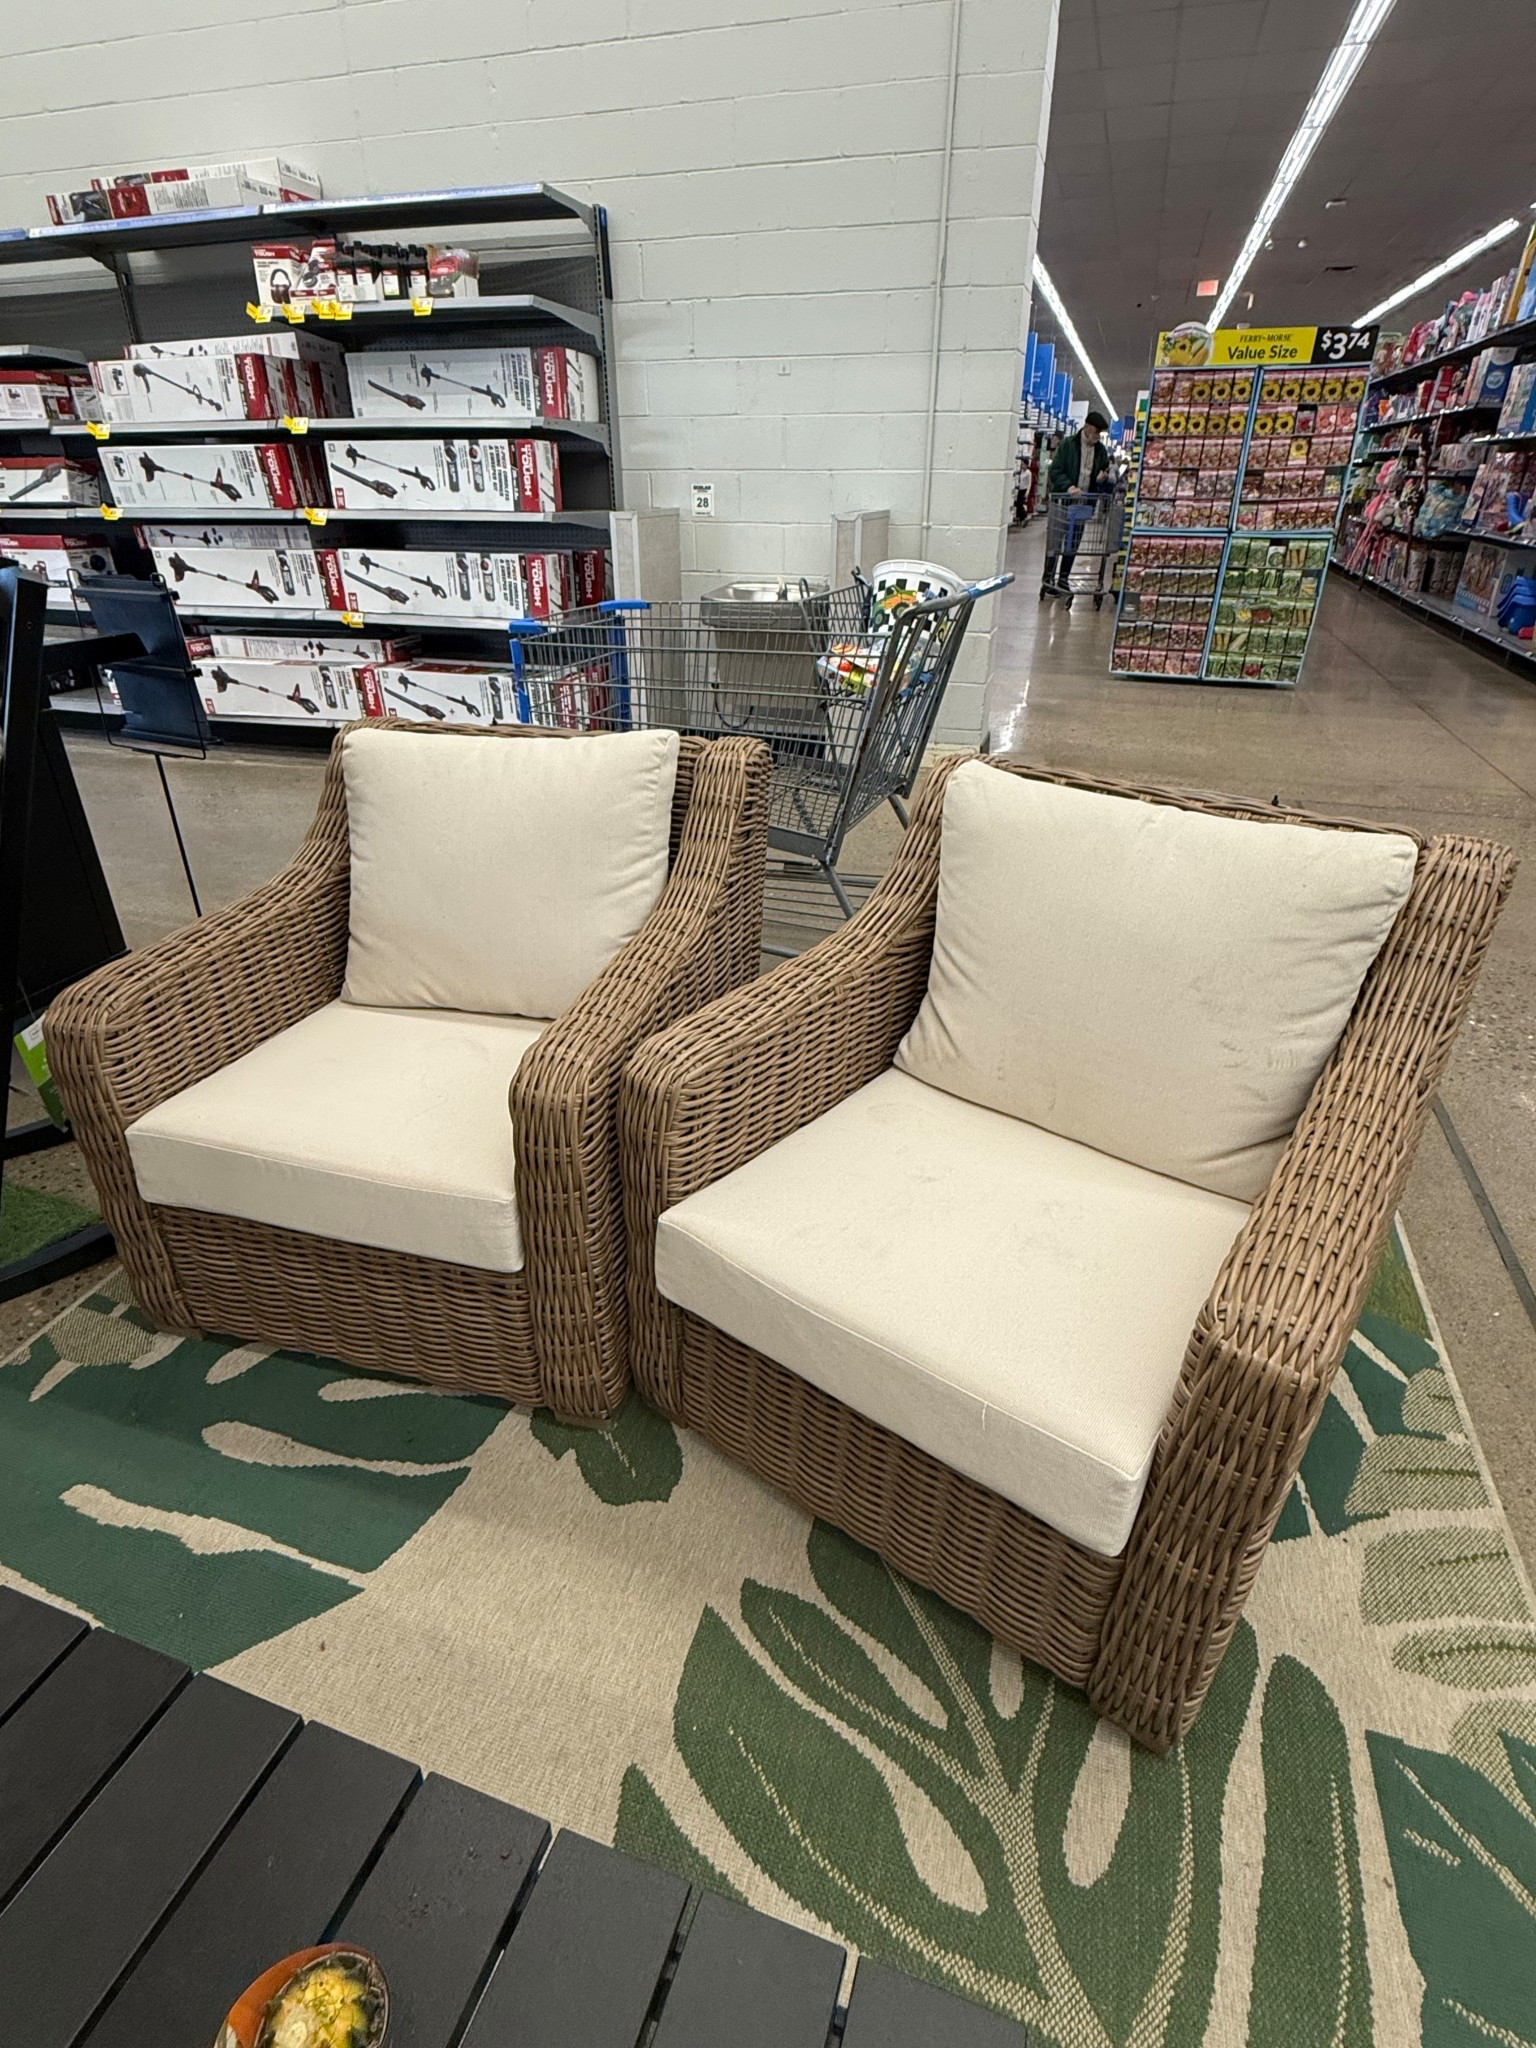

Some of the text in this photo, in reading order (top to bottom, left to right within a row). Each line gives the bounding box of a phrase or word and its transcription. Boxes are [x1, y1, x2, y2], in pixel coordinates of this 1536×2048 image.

[1228, 345, 1298, 360] Value Size
[544, 354, 554, 405] TOUGH
[521, 446, 532, 496] TOUGH
[696, 497, 709, 508] 28
[326, 555, 338, 596] TOUGH
[531, 561, 542, 606] TOUGH
[584, 556, 592, 598] TOUGH
[363, 672, 375, 709] TOUGH
